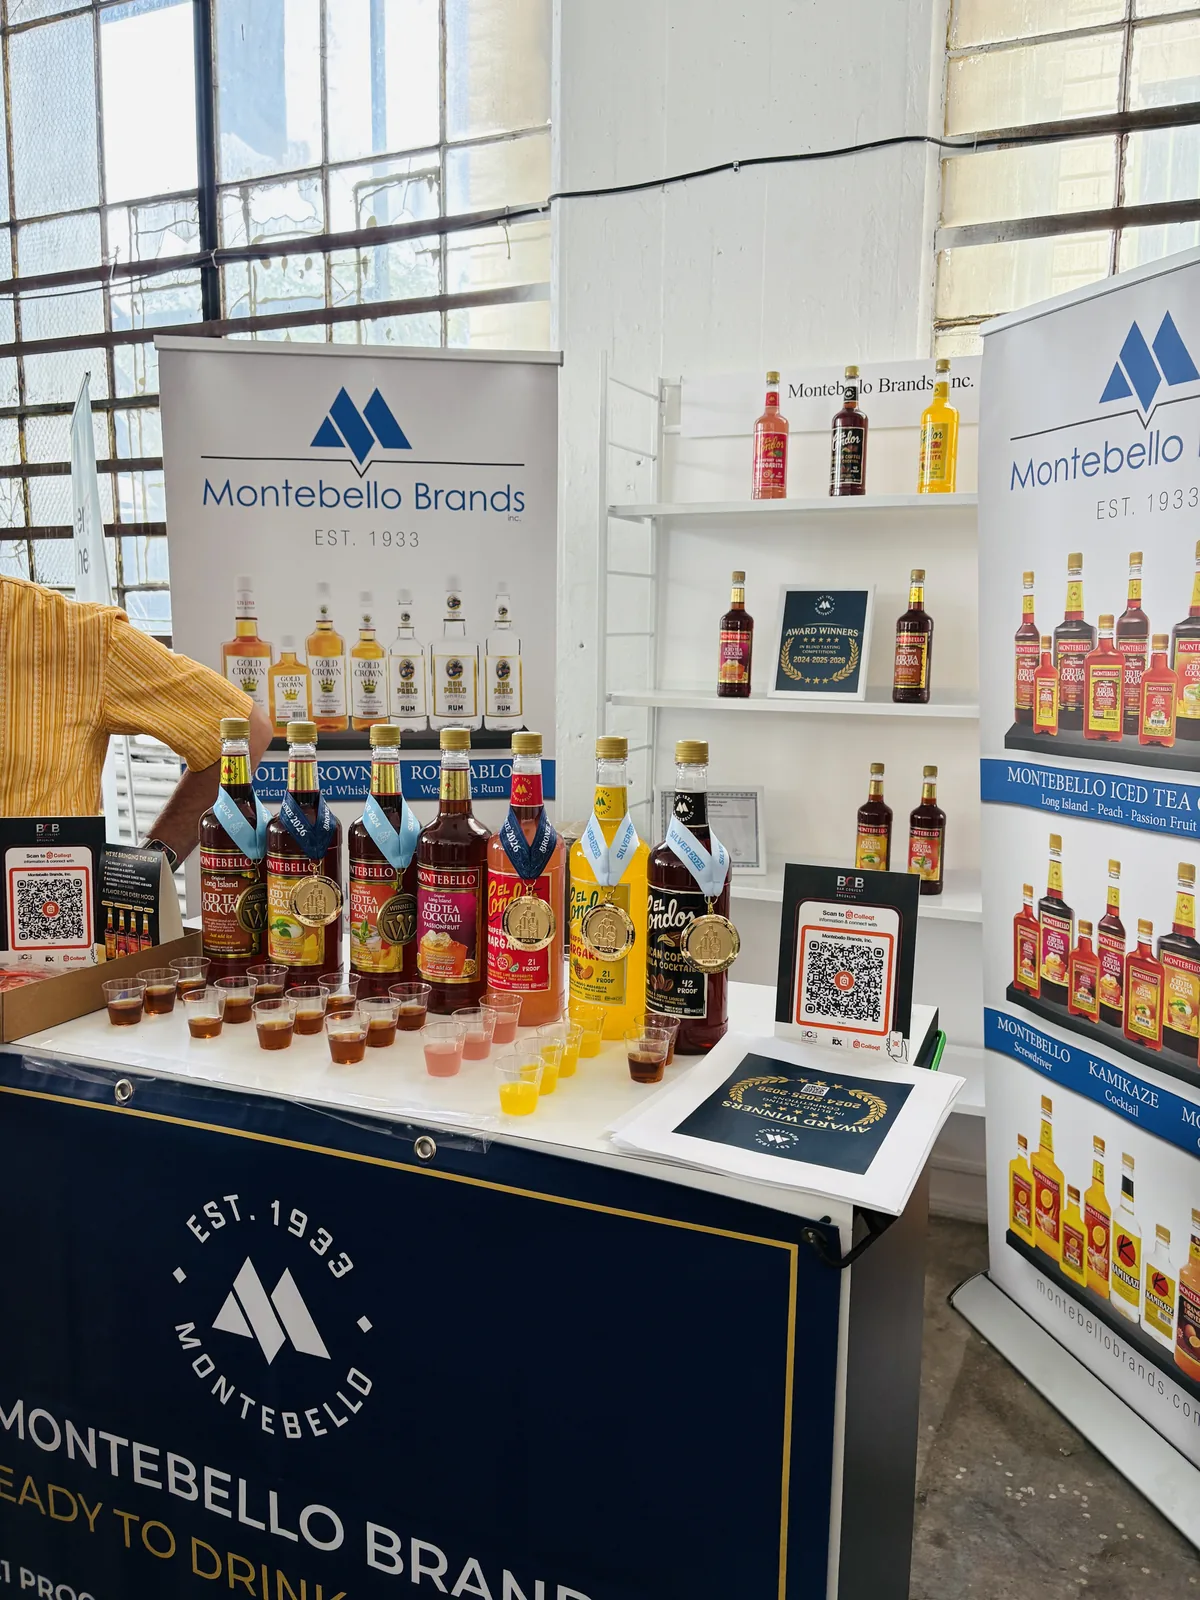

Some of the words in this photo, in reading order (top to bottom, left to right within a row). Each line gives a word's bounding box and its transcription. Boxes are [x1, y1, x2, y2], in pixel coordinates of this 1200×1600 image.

[788, 378, 873, 398] Monteblo
[951, 376, 974, 389] nc.
[1010, 430, 1184, 490] Montebello
[203, 478, 401, 509] Montebello
[414, 482, 525, 512] Brands
[1097, 496, 1135, 520] EST.
[1147, 487, 1199, 513] 1933
[507, 514, 522, 522] inc.
[315, 529, 356, 546] EST.
[369, 530, 420, 548] 1933
[786, 627, 817, 637] AWARD
[819, 627, 859, 637] WINNERS
[237, 659, 261, 667] GOLD
[315, 659, 338, 667] GOLD
[358, 661, 380, 669] GOLD
[232, 667, 266, 676] CROWN
[312, 667, 342, 676] CROWN
[354, 669, 383, 678] CROWN
[1061, 674, 1085, 682] COCKTAI
[317, 765, 371, 781] ROWN
[469, 763, 514, 779] ABLO
[481, 783, 504, 794] Rum
[1007, 766, 1106, 797] MONTEBELLO
[1111, 781, 1148, 804] ICED
[1152, 788, 1192, 812] TEA
[219, 801, 234, 820] 2024
[1041, 793, 1060, 811] Long
[1062, 798, 1088, 813] Island
[1098, 803, 1123, 819] Peach
[1131, 809, 1167, 827] Passion
[1170, 816, 1197, 832] Fruit
[290, 815, 308, 837] 2026
[506, 829, 521, 853] 2026
[616, 835, 631, 860] SILVER
[670, 830, 692, 856] SILVER
[687, 850, 706, 871] 2025
[200, 856, 253, 868] ONTEBELLO
[266, 859, 314, 873] ONTEBELLO
[350, 865, 394, 878] NTEBELLO
[204, 879, 217, 889] Long
[217, 880, 239, 888] Island
[837, 875, 865, 889] BCB
[497, 883, 510, 896] EL
[203, 891, 220, 903] ICED
[221, 893, 241, 904] TEA
[268, 897, 290, 909] COCKT
[362, 895, 377, 905] TEA
[576, 891, 587, 903] EL
[203, 902, 237, 915] COCKTA
[423, 902, 441, 913] ICED
[442, 904, 460, 914] TEA
[653, 899, 665, 912] EL
[422, 910, 462, 924] COCKTAIL
[1042, 916, 1070, 930] MONTEBELLO
[423, 921, 460, 930] PASSIONFRUIT
[821, 933, 846, 941] Montebello
[527, 958, 536, 966] 21
[1164, 956, 1200, 973] MONTEBELLO
[602, 970, 610, 978] 21
[1132, 971, 1158, 984] MONTEBELLO
[681, 979, 693, 988] 42
[677, 987, 698, 995] PROOF
[997, 1016, 1071, 1063] MONTEBELLO
[1088, 1060, 1160, 1109] KAMIKAZE
[1014, 1041, 1053, 1072] Screwdriver
[1105, 1089, 1139, 1118] Cocktail
[762, 1097, 800, 1108] TASTING
[773, 1095, 841, 1111] COMPETITIONS
[722, 1100, 798, 1123] WINNERS
[803, 1105, 832, 1114] BLIND
[803, 1118, 872, 1133] AWARD
[186, 1194, 256, 1243] EST.
[270, 1199, 354, 1279] 1933
[1145, 1289, 1174, 1316] KAMIKAZE
[174, 1321, 373, 1439] MONTEBELLO
[0, 1398, 345, 1552] MONTEBELLO
[0, 1465, 102, 1533] EADY
[113, 1508, 177, 1559] TO
[0, 1559, 11, 1584] 1
